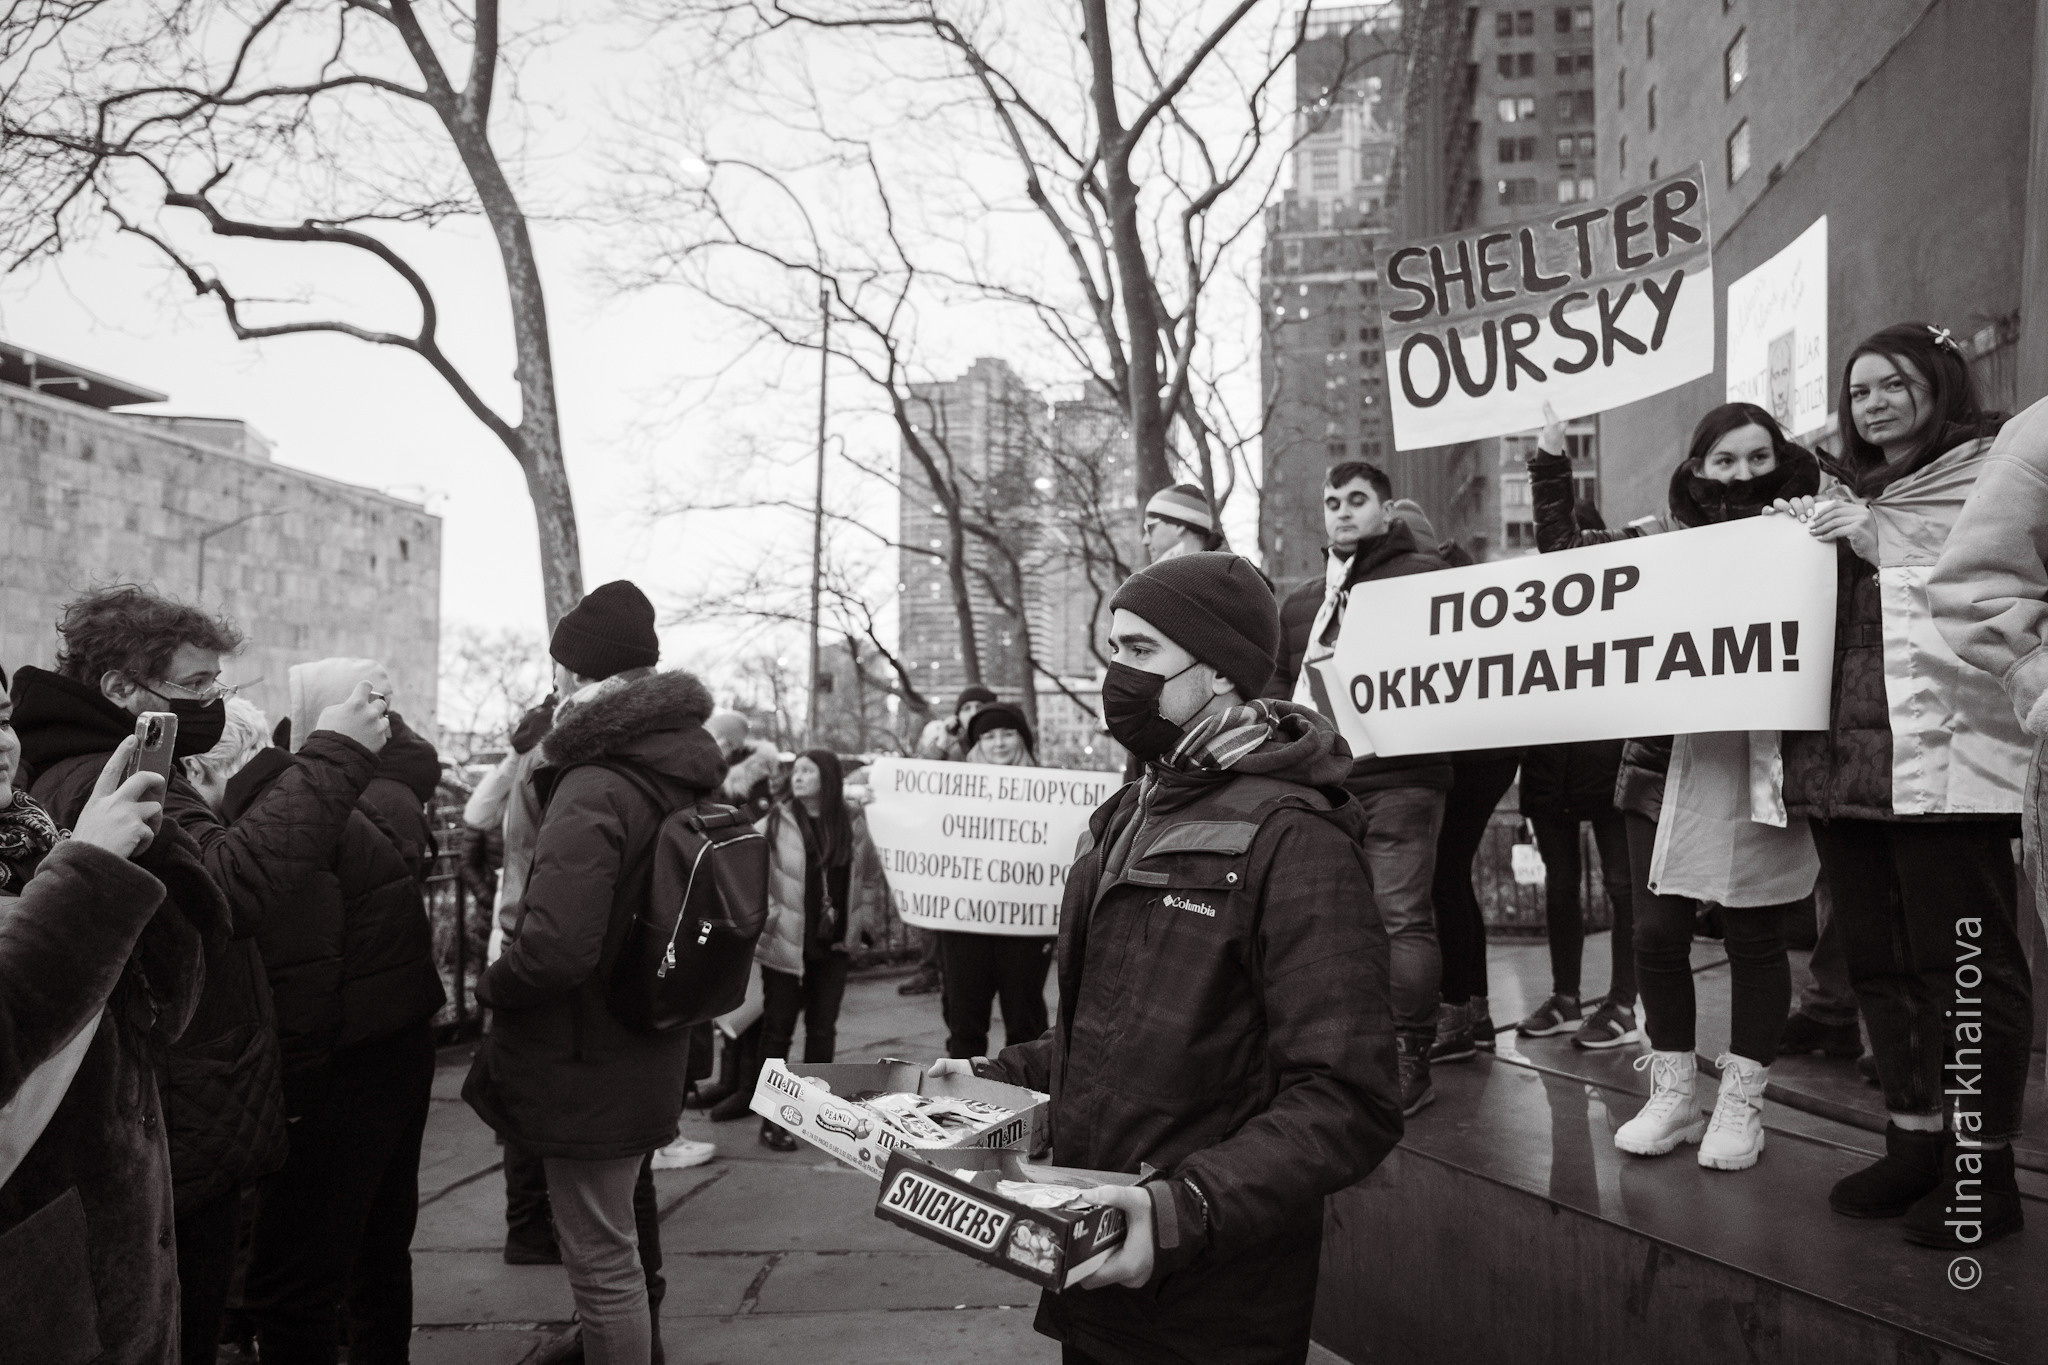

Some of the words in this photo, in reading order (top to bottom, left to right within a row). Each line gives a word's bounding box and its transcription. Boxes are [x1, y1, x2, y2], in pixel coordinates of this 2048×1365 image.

[1387, 179, 1702, 322] SHELTER
[1429, 565, 1640, 636] ПОЗОР
[1350, 620, 1800, 715] ОККУПАНТАМ!
[894, 768, 993, 803] РОССИЯНЕ,
[942, 813, 1049, 846] ОЧНИТЕСЬ!
[894, 850, 983, 881] ПОЗОРЬТЕ
[987, 858, 1044, 886] СВОЮ
[912, 892, 950, 920] МИР
[954, 897, 1049, 926] СМОТРИТ
[1172, 896, 1216, 917] Columbia
[782, 1106, 794, 1122] 48
[824, 1108, 851, 1126] PEANUT
[889, 1175, 1004, 1246] SNICKERS
